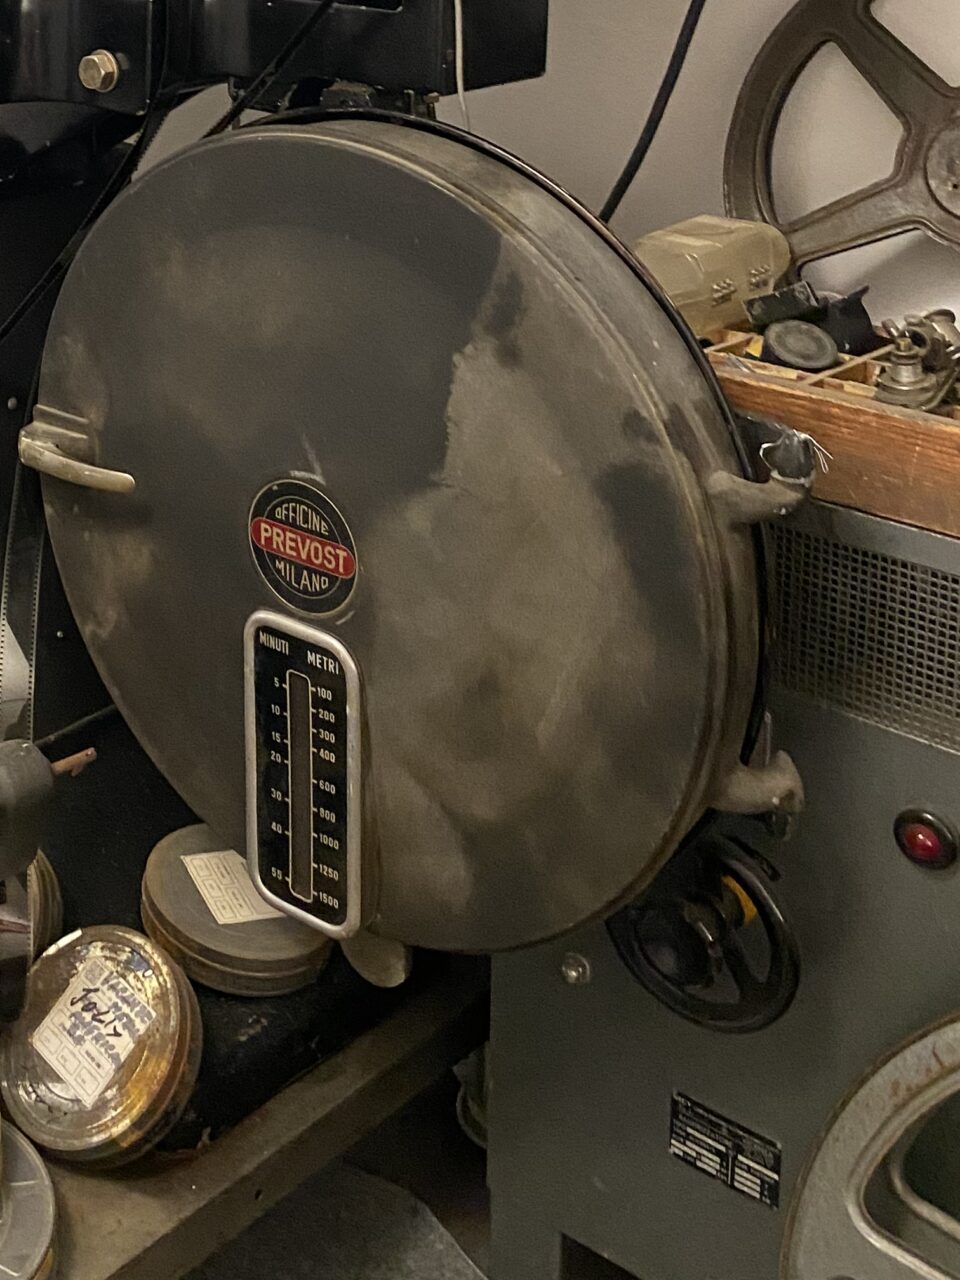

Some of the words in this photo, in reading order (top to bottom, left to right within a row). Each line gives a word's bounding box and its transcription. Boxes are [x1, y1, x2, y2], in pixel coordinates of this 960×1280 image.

[274, 502, 330, 536] OFFICINE
[260, 522, 348, 574] PREVOST
[275, 559, 330, 593] MILANO
[259, 630, 290, 656] MINUTI
[306, 649, 340, 676] METRI
[273, 676, 280, 688] 5
[317, 686, 333, 701] 100
[271, 704, 281, 716] 10
[318, 708, 336, 723] 200
[271, 731, 281, 743] 15
[318, 730, 336, 744] 300
[270, 750, 281, 764] 20
[319, 749, 336, 764] 400
[270, 787, 282, 801] 30
[319, 780, 336, 795] 600
[319, 807, 336, 823] 800
[271, 821, 282, 834] 40
[319, 833, 339, 850] 1000
[271, 866, 282, 880] 55
[319, 863, 339, 881] 1250
[319, 891, 339, 909] 1500
